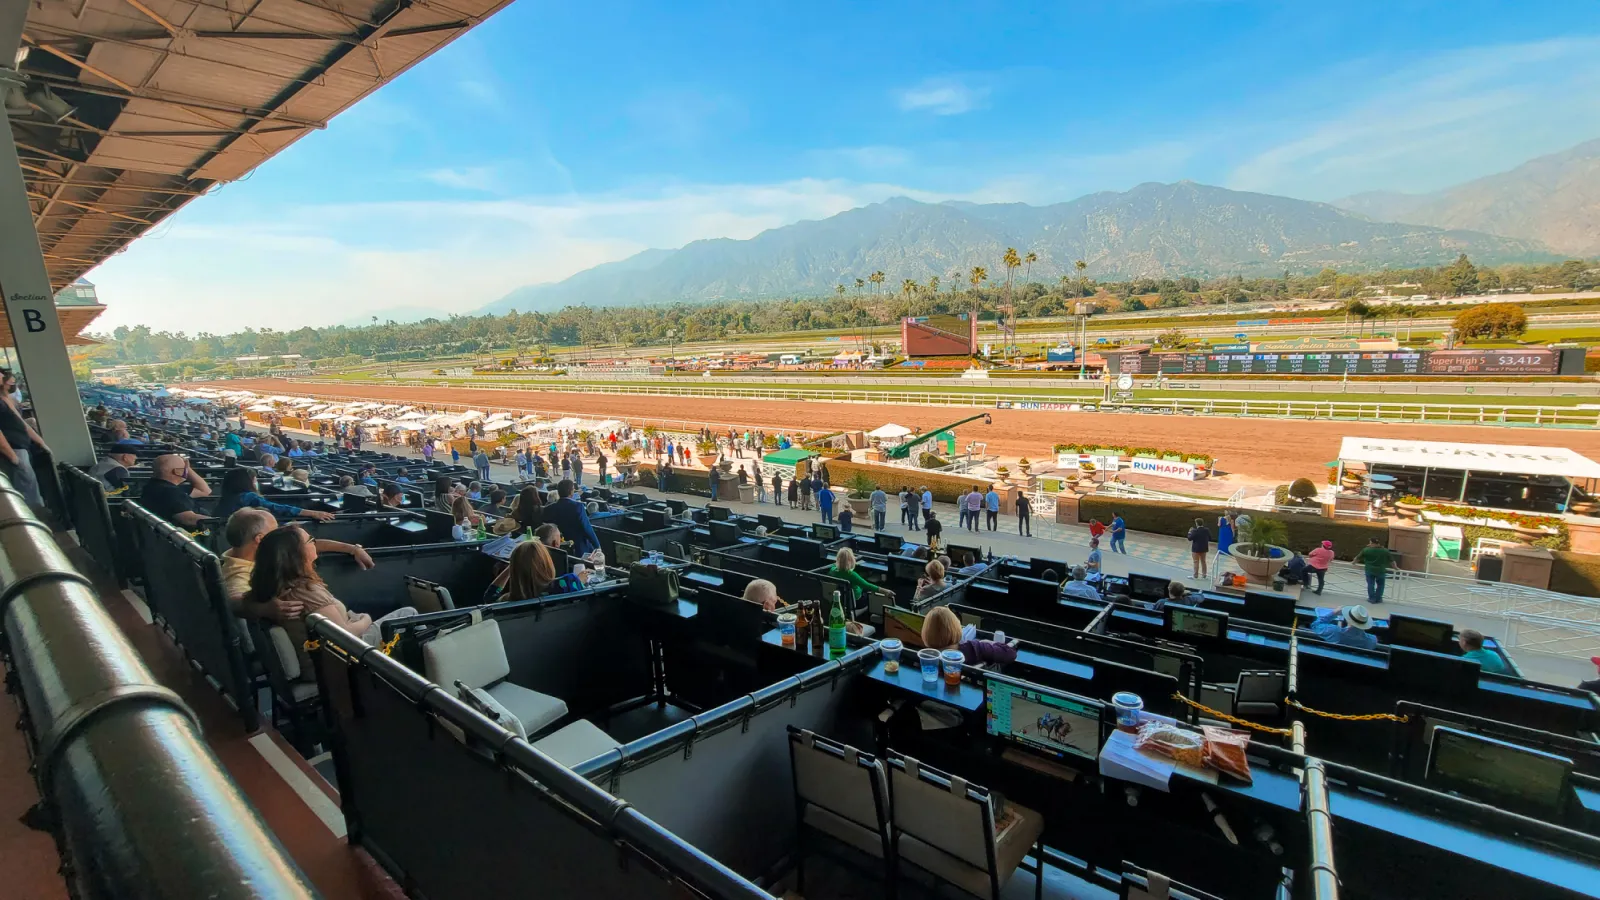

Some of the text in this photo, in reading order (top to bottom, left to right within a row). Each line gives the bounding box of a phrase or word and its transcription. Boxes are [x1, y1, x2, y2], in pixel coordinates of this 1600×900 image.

[10, 293, 47, 301] Section
[22, 309, 46, 333] B
[1295, 342, 1323, 350] Anita
[1325, 342, 1352, 350] Park
[1428, 356, 1454, 366] Super
[1455, 356, 1477, 366] High
[1479, 356, 1486, 365] 5
[1498, 356, 1541, 366] $3,412
[1020, 402, 1072, 410] RUNHAPPY
[1133, 461, 1193, 476] RUNHAPPY
